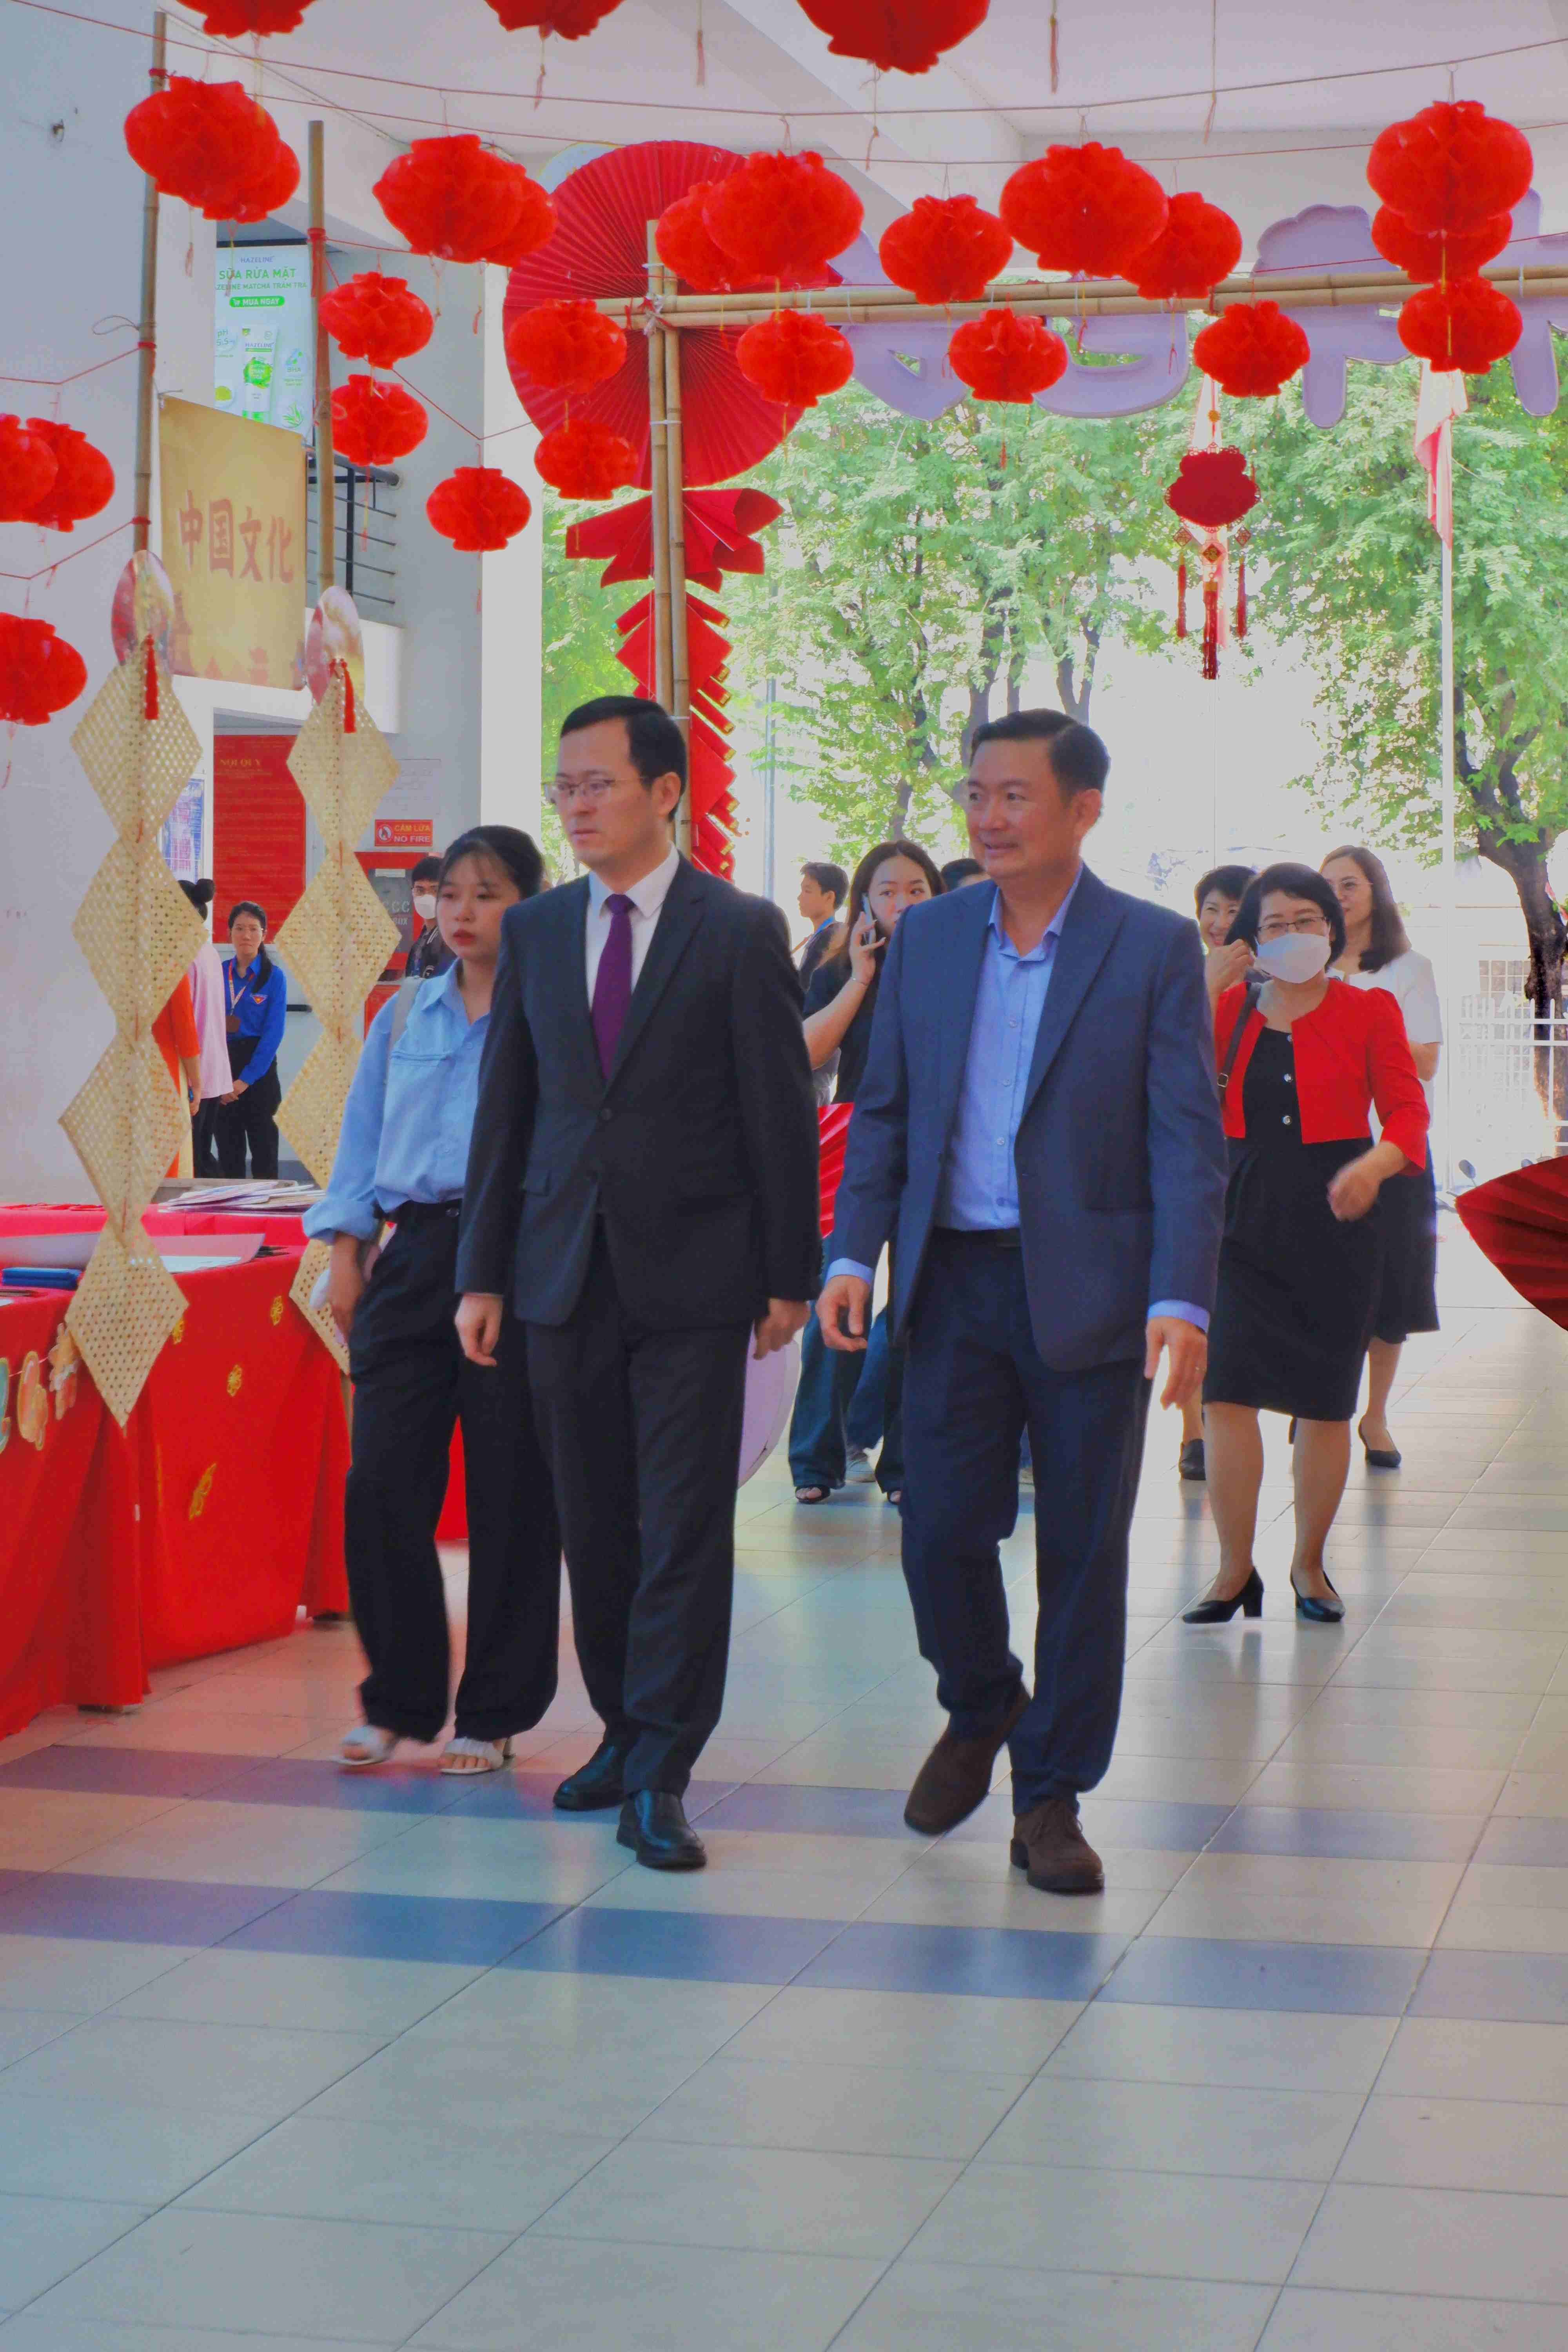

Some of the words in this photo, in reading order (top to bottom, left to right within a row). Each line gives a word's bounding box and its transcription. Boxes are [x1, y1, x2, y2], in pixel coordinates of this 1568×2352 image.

[219, 267, 242, 279] SỮA
[245, 266, 269, 279] RỬA
[272, 266, 296, 280] MẶT
[179, 489, 294, 584] 中国文化
